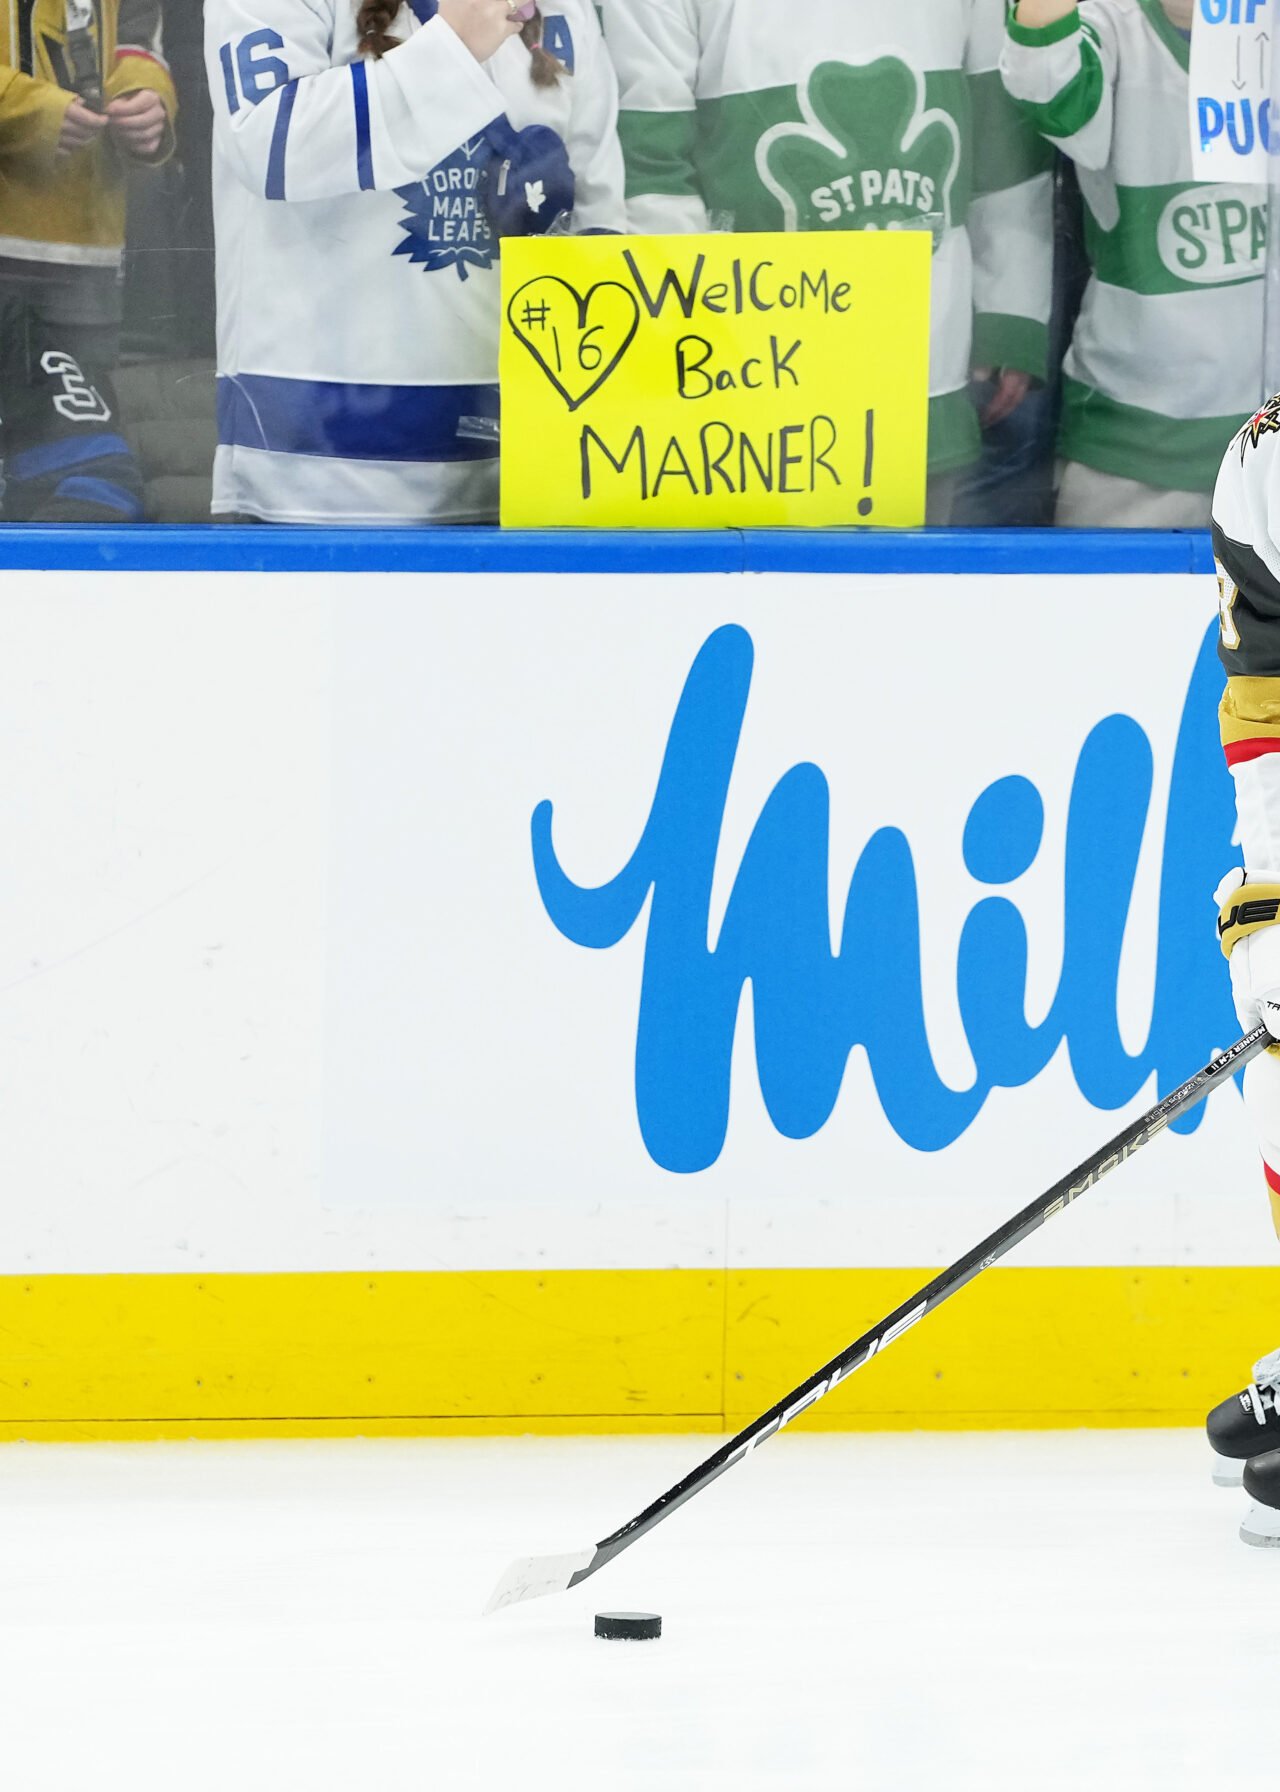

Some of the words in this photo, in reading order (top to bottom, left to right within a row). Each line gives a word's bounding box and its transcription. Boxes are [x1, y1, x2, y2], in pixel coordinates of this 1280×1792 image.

[219, 28, 290, 115] 16
[861, 169, 935, 213] PATS
[1231, 1025, 1267, 1055] MARNER
